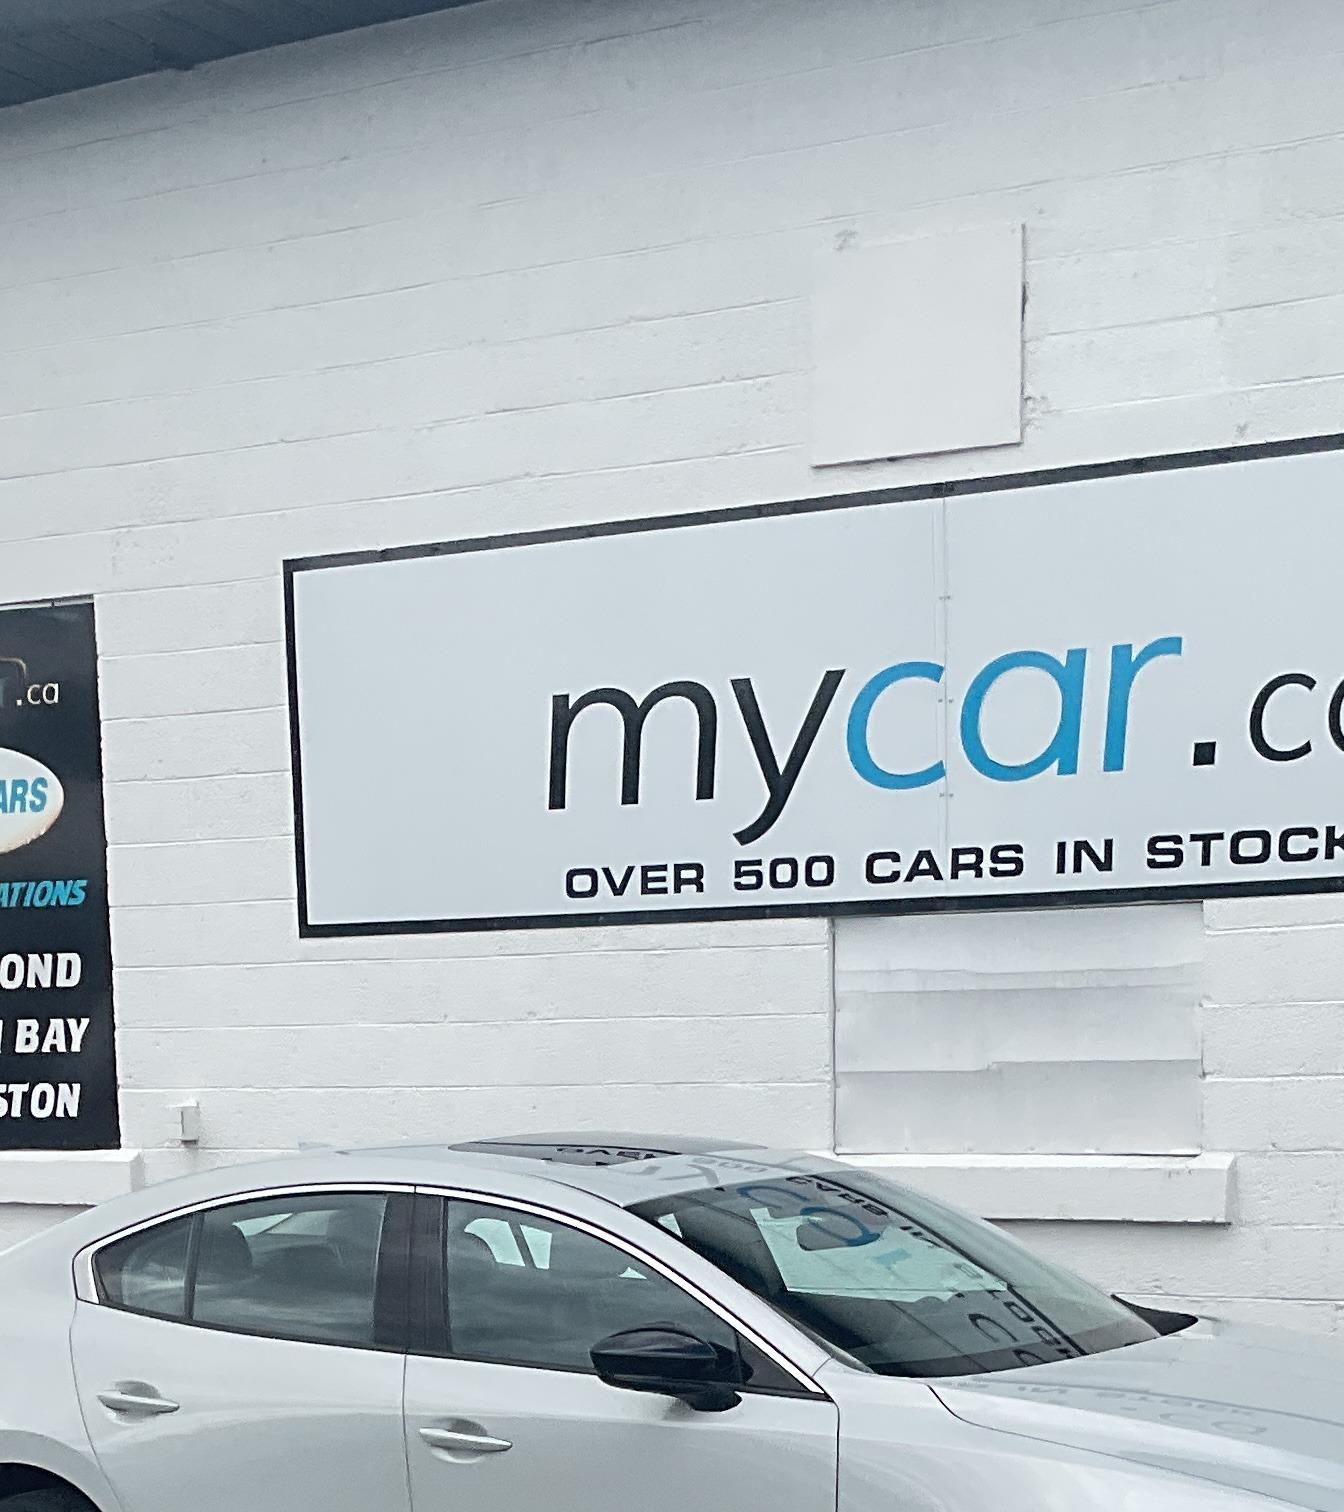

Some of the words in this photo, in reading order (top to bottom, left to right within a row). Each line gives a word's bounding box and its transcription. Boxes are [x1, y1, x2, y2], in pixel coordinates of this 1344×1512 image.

[566, 863, 704, 898] OVER
[734, 855, 834, 890] 500
[866, 844, 1023, 884] CARS
[1056, 838, 1113, 874] IN
[15, 1018, 89, 1053] BAY
